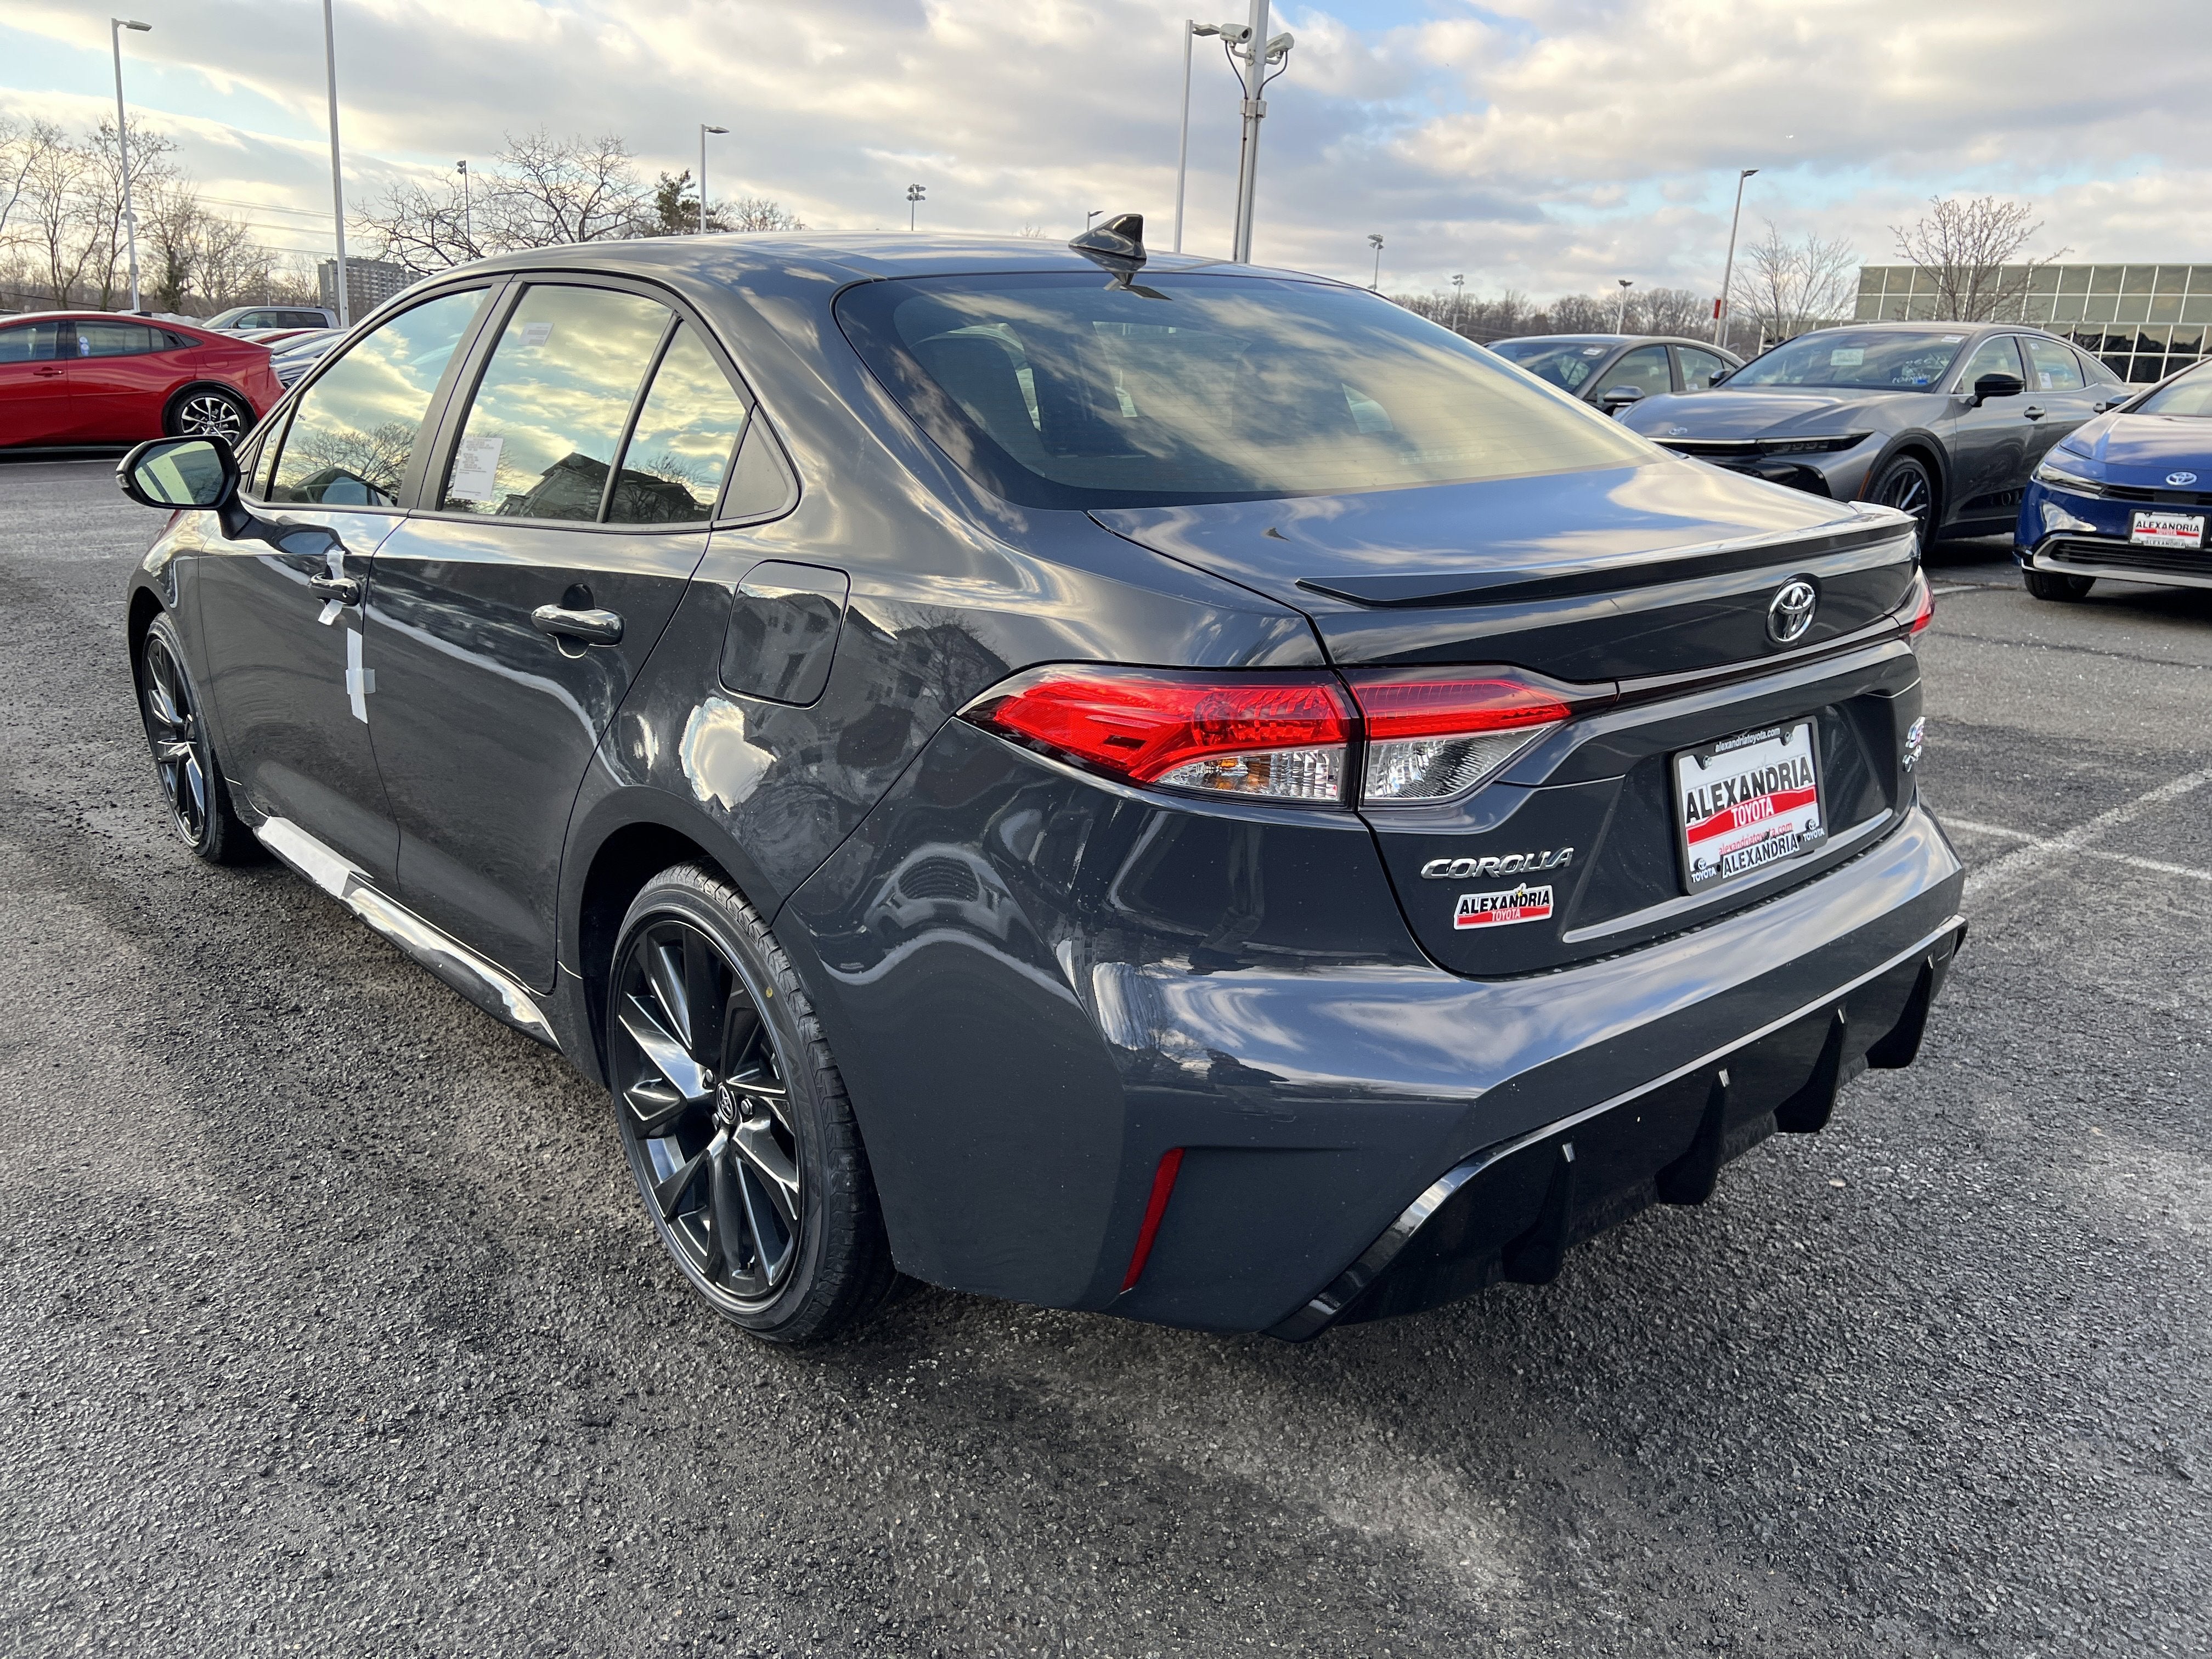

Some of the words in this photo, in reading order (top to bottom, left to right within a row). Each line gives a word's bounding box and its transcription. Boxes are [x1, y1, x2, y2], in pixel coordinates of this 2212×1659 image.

[2136, 521, 2199, 532] ALEXANDRIA
[1715, 727, 1781, 753] alexandriatoyota.com
[1685, 756, 1815, 823] ALEXANDRIA
[1731, 797, 1774, 828] TOYOTA
[1803, 827, 1825, 842] TOYOTA
[1420, 847, 1575, 879] COROLLA
[1723, 832, 1799, 877] ALEXANDRIA
[1691, 866, 1717, 883] TOYOTA
[1459, 890, 1550, 915] ALEXANDRIA
[1491, 908, 1521, 922] TOYOTA
